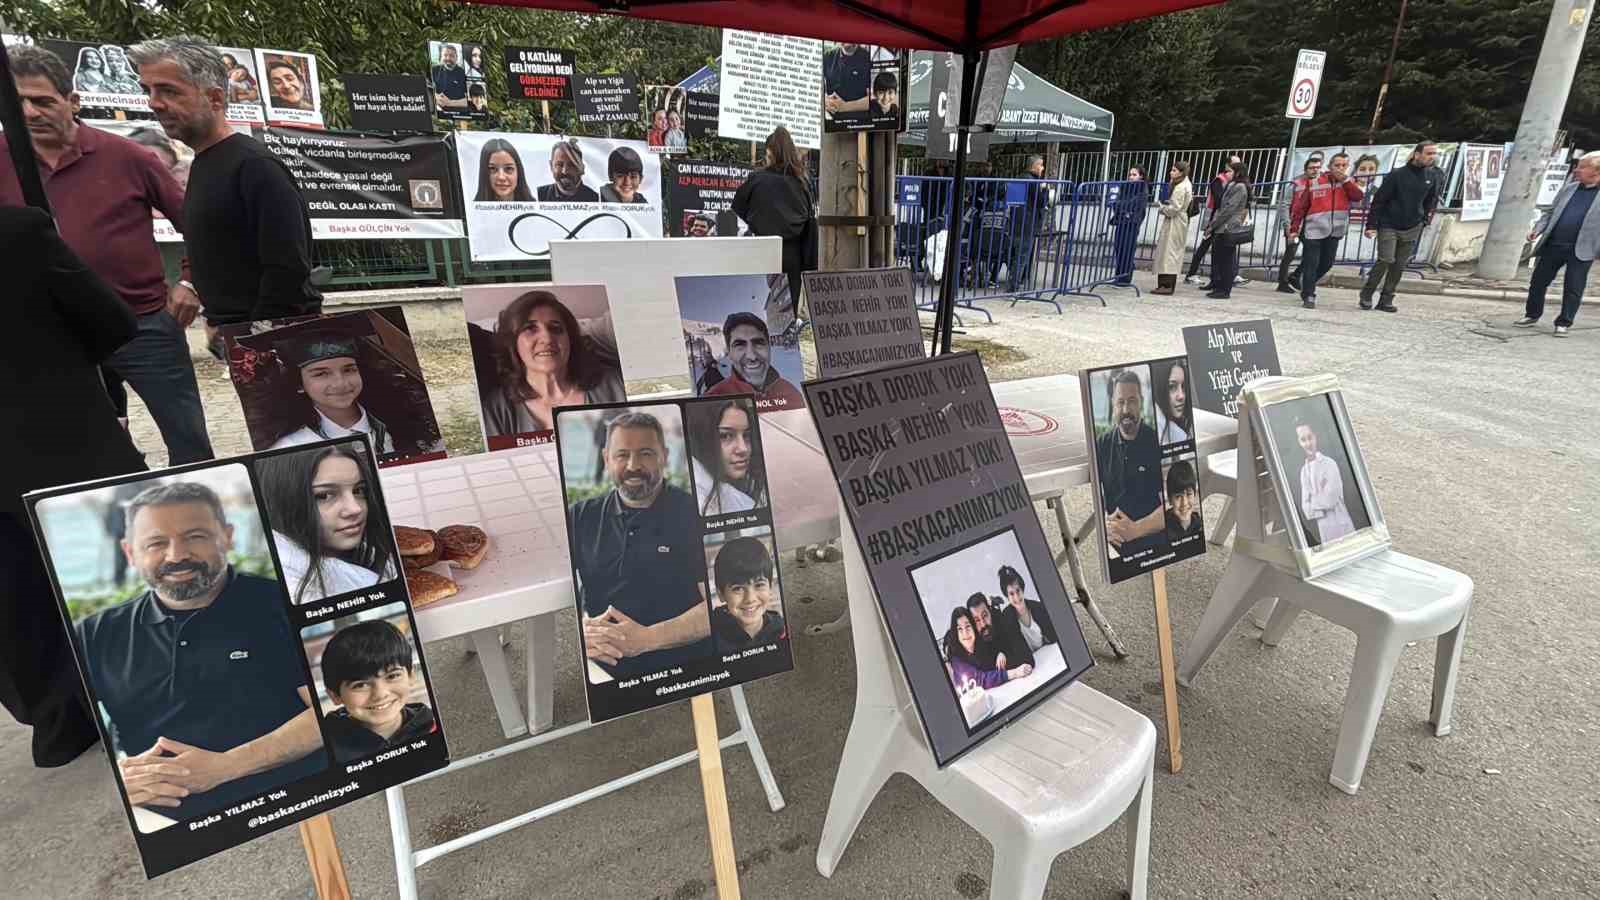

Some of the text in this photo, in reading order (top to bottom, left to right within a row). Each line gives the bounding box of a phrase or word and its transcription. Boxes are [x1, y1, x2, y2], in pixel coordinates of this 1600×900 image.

[520, 50, 562, 63] O KATLİAM
[510, 61, 554, 74] GELİYORUM
[352, 92, 425, 103] Her isim bir hayat!
[1297, 87, 1311, 105] 30
[353, 102, 426, 112] her hayat için adalet!
[264, 133, 281, 144] Biz
[304, 148, 345, 158] vicdanla
[347, 150, 411, 162] birleşmedikçe
[343, 173, 368, 182] yasal
[370, 172, 393, 183] değil
[678, 163, 692, 174] CAN
[692, 165, 729, 176] KURTARMAK
[305, 182, 318, 190] ve
[319, 181, 360, 191] evrensel
[309, 200, 396, 211] DEĞİL OLASI KASTI
[329, 224, 356, 234] Başka
[359, 223, 393, 234] GÜLÇİN
[395, 224, 411, 232] Yok
[809, 272, 904, 295] BAŞKA DORUK YOK!
[814, 294, 908, 318] BAŞKA NEHİR YOK!
[817, 316, 913, 341] BAŞKA YILMAZ YOK!
[1207, 328, 1258, 353] Alp Mercan
[1231, 350, 1243, 363] ve
[817, 362, 977, 418] BAŞKA DORUK YOK!
[1208, 368, 1234, 395] Yiğit
[774, 398, 787, 406] Yok
[832, 400, 991, 463] BAŞKA NEHİR YOK!
[516, 435, 548, 448] Başka
[849, 438, 1005, 507] BAŞKA YILMAZ YOK!
[867, 481, 1028, 566] #BAŞKACANIMIZYOK
[305, 591, 387, 619] Başka NEHİR Yok
[722, 653, 742, 663] Başka
[742, 646, 765, 658] DORUK
[618, 667, 684, 689] Başka YILMAZ Yok
[655, 670, 731, 696] @baskacanimizyok
[345, 739, 428, 775] Başka DORUK Yok
[189, 789, 289, 831] Başka YILMAZ Yok
[247, 780, 360, 829] @baskacanimizyok
